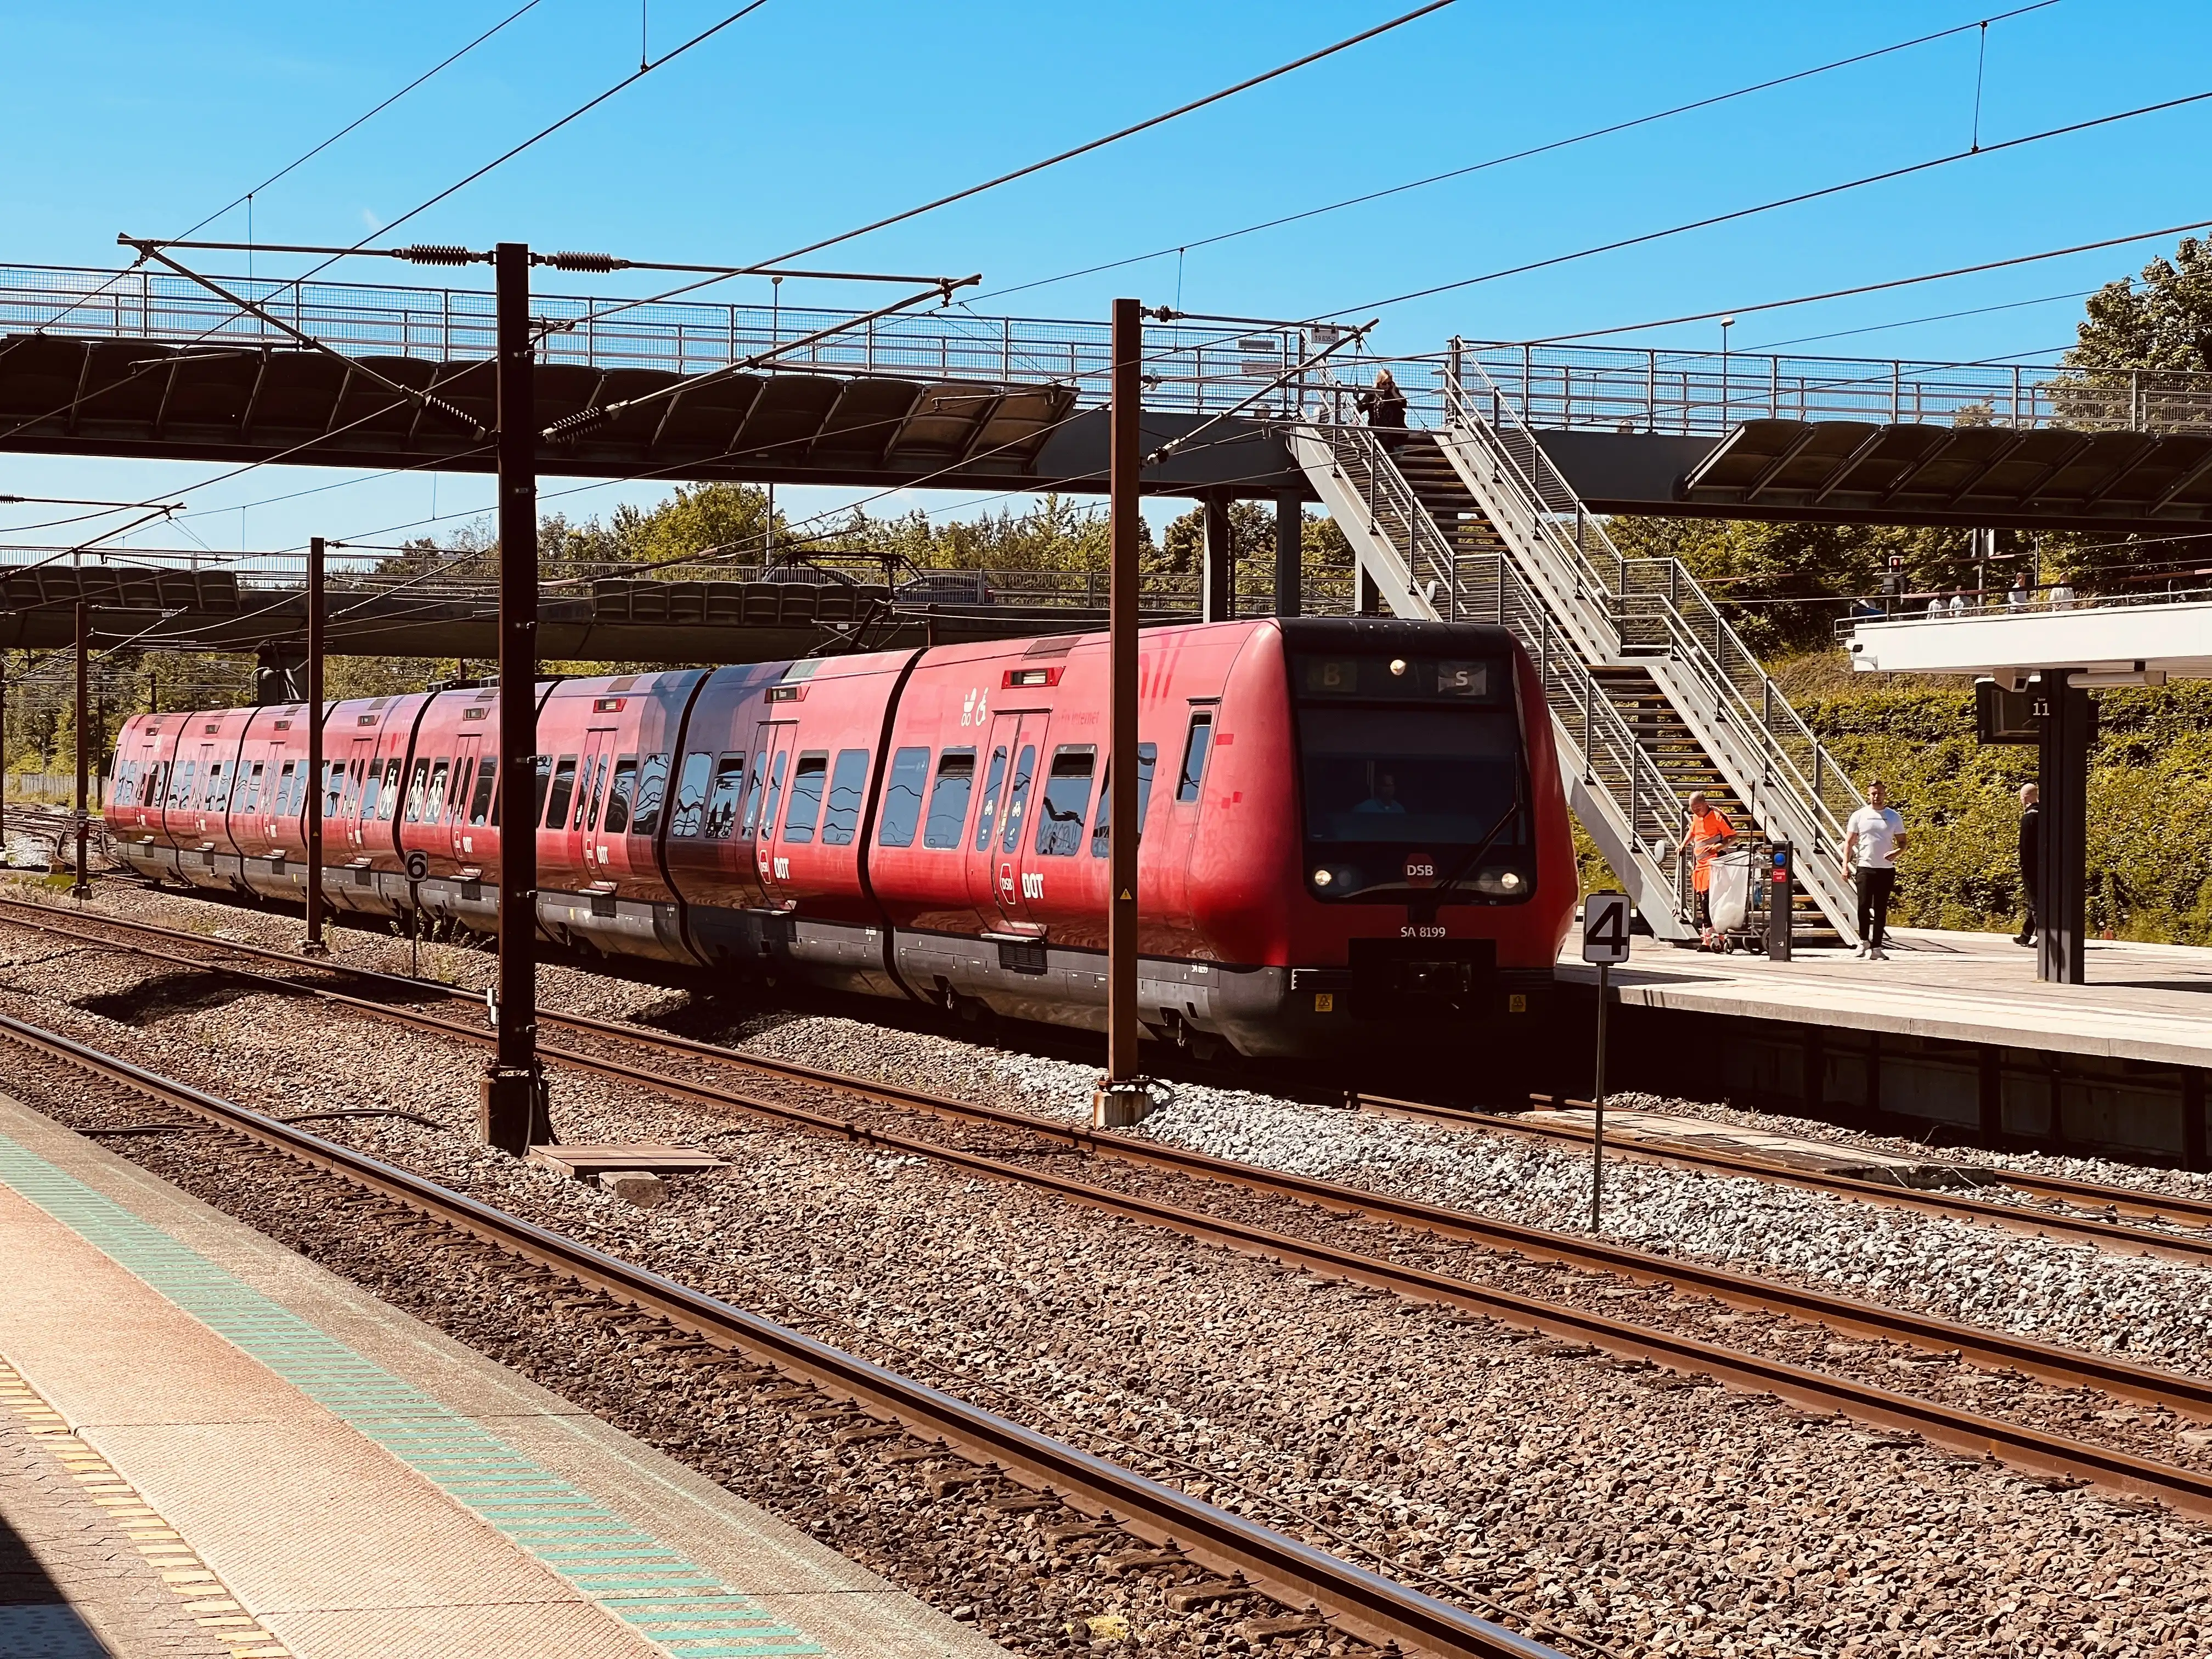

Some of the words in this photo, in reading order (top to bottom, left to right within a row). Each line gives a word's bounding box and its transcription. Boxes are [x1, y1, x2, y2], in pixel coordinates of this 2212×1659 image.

[1324, 663, 1340, 685] B
[1455, 670, 1468, 686] S
[2033, 703, 2050, 715] 11
[596, 845, 609, 865] DOT
[407, 853, 426, 879] 6
[774, 857, 790, 879] DOT
[1407, 865, 1434, 876] DSB
[1001, 878, 1013, 890] DSB
[1022, 873, 1044, 899] DOT
[1401, 927, 1416, 938] SA
[1419, 927, 1446, 938] 8199
[1586, 902, 1628, 956] 4
